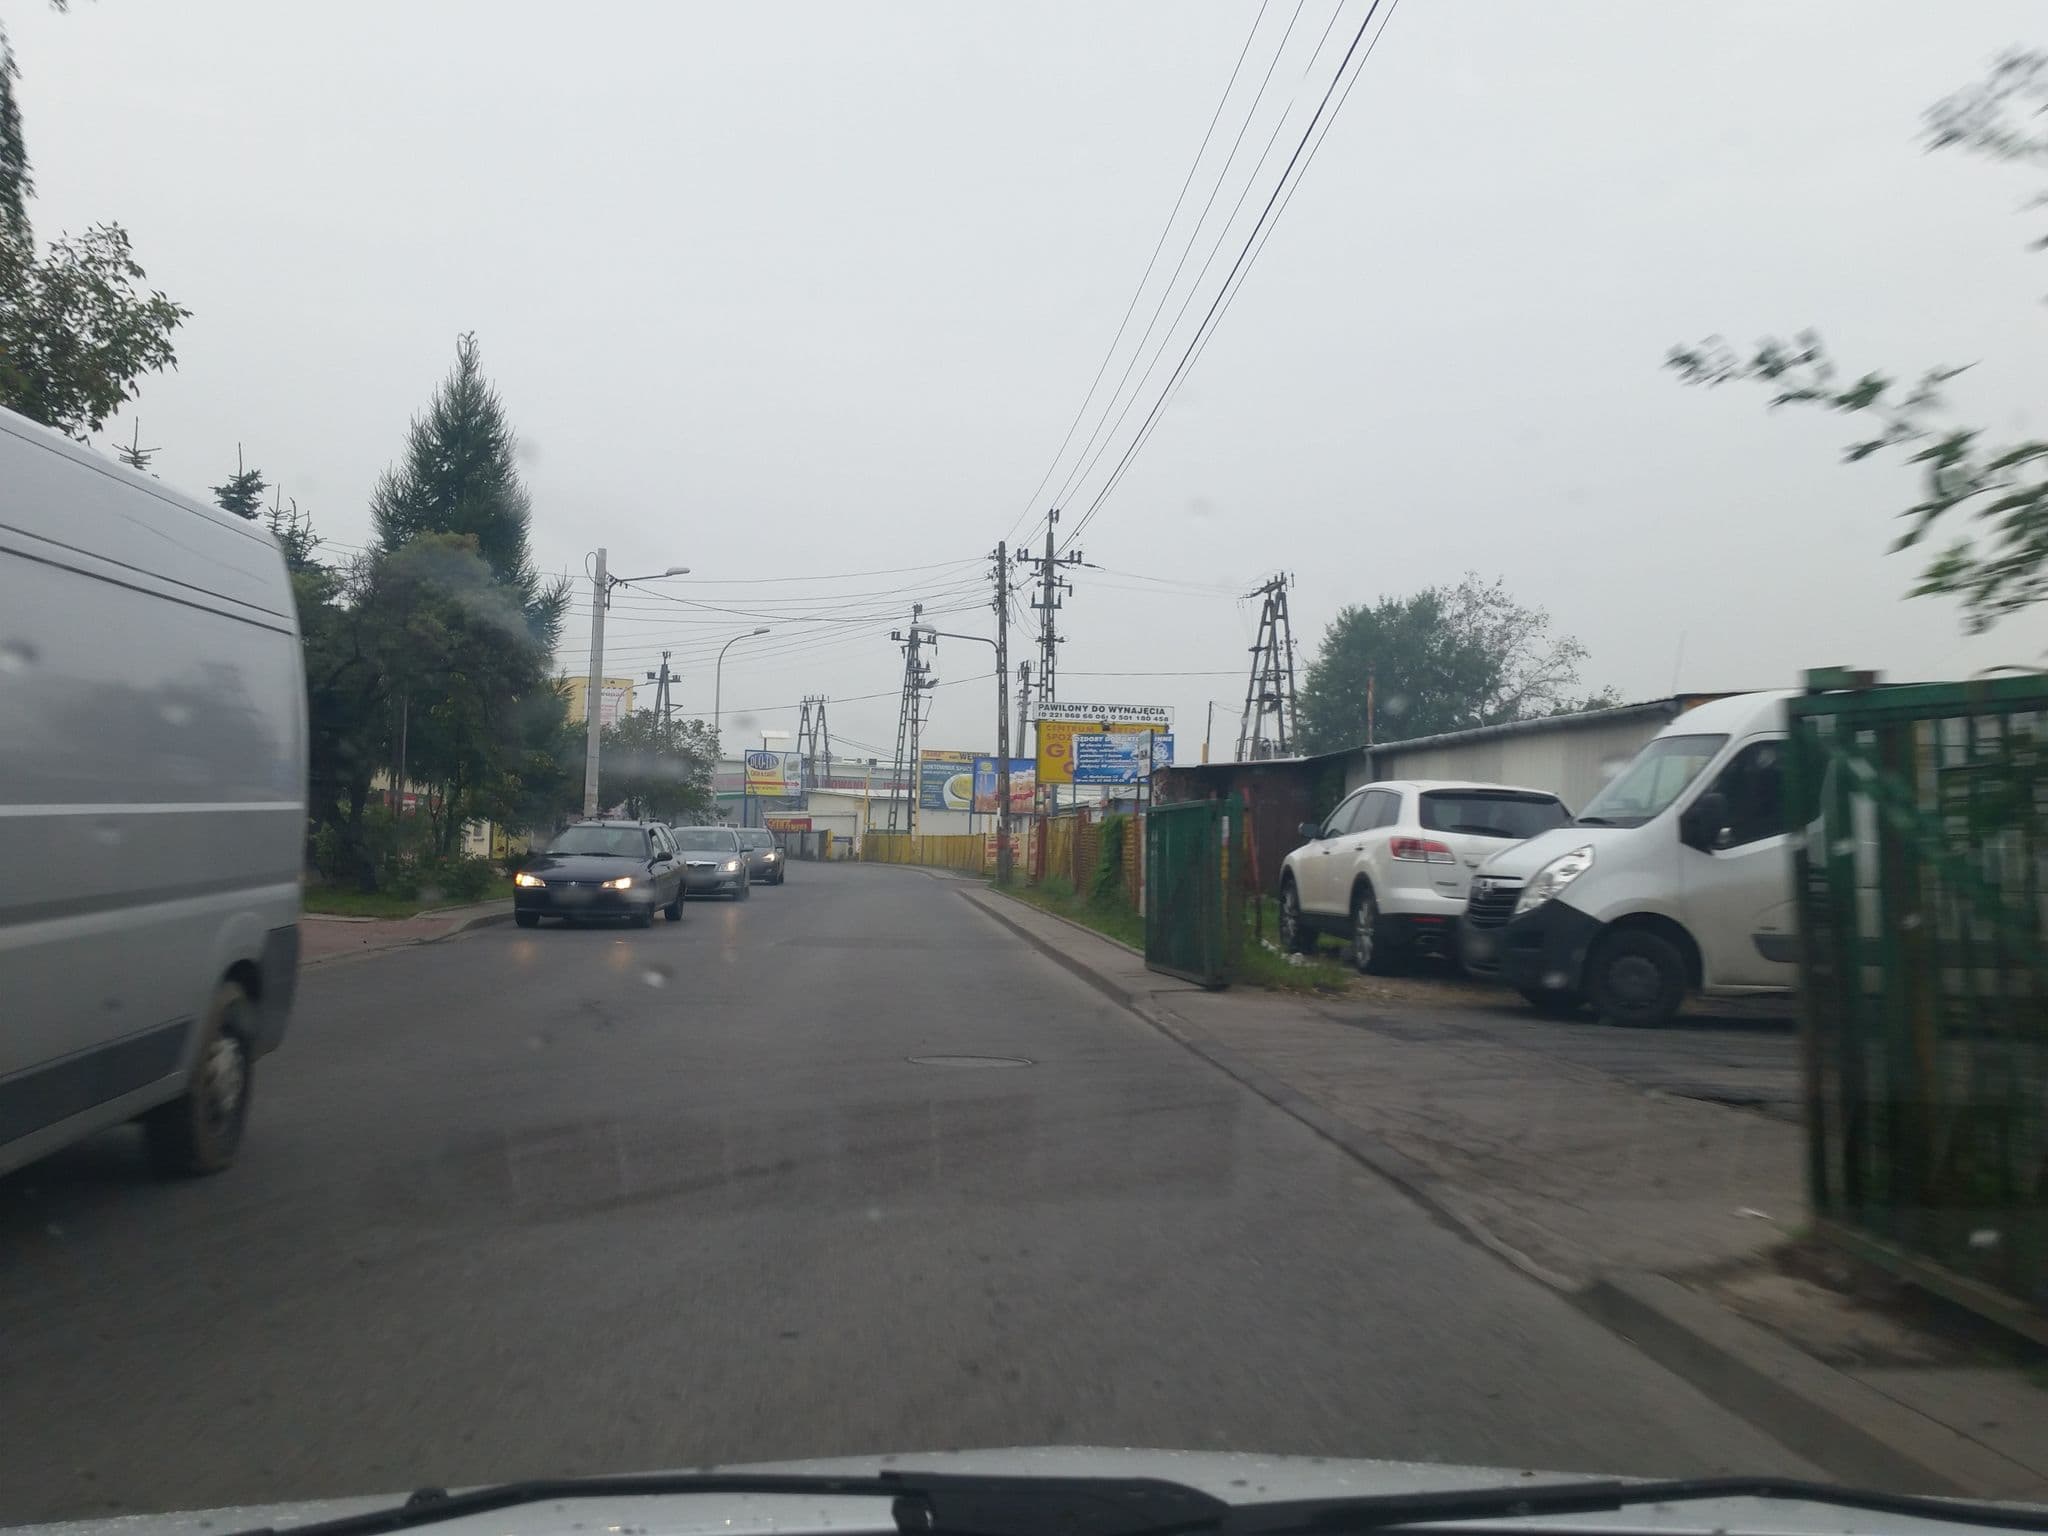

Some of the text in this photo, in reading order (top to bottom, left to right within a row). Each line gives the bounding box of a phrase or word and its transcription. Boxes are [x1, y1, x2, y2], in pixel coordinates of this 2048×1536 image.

[1038, 703, 1166, 715] PAWILONY DO WYNAJĘCIA
[1046, 724, 1095, 734] CENTRUM
